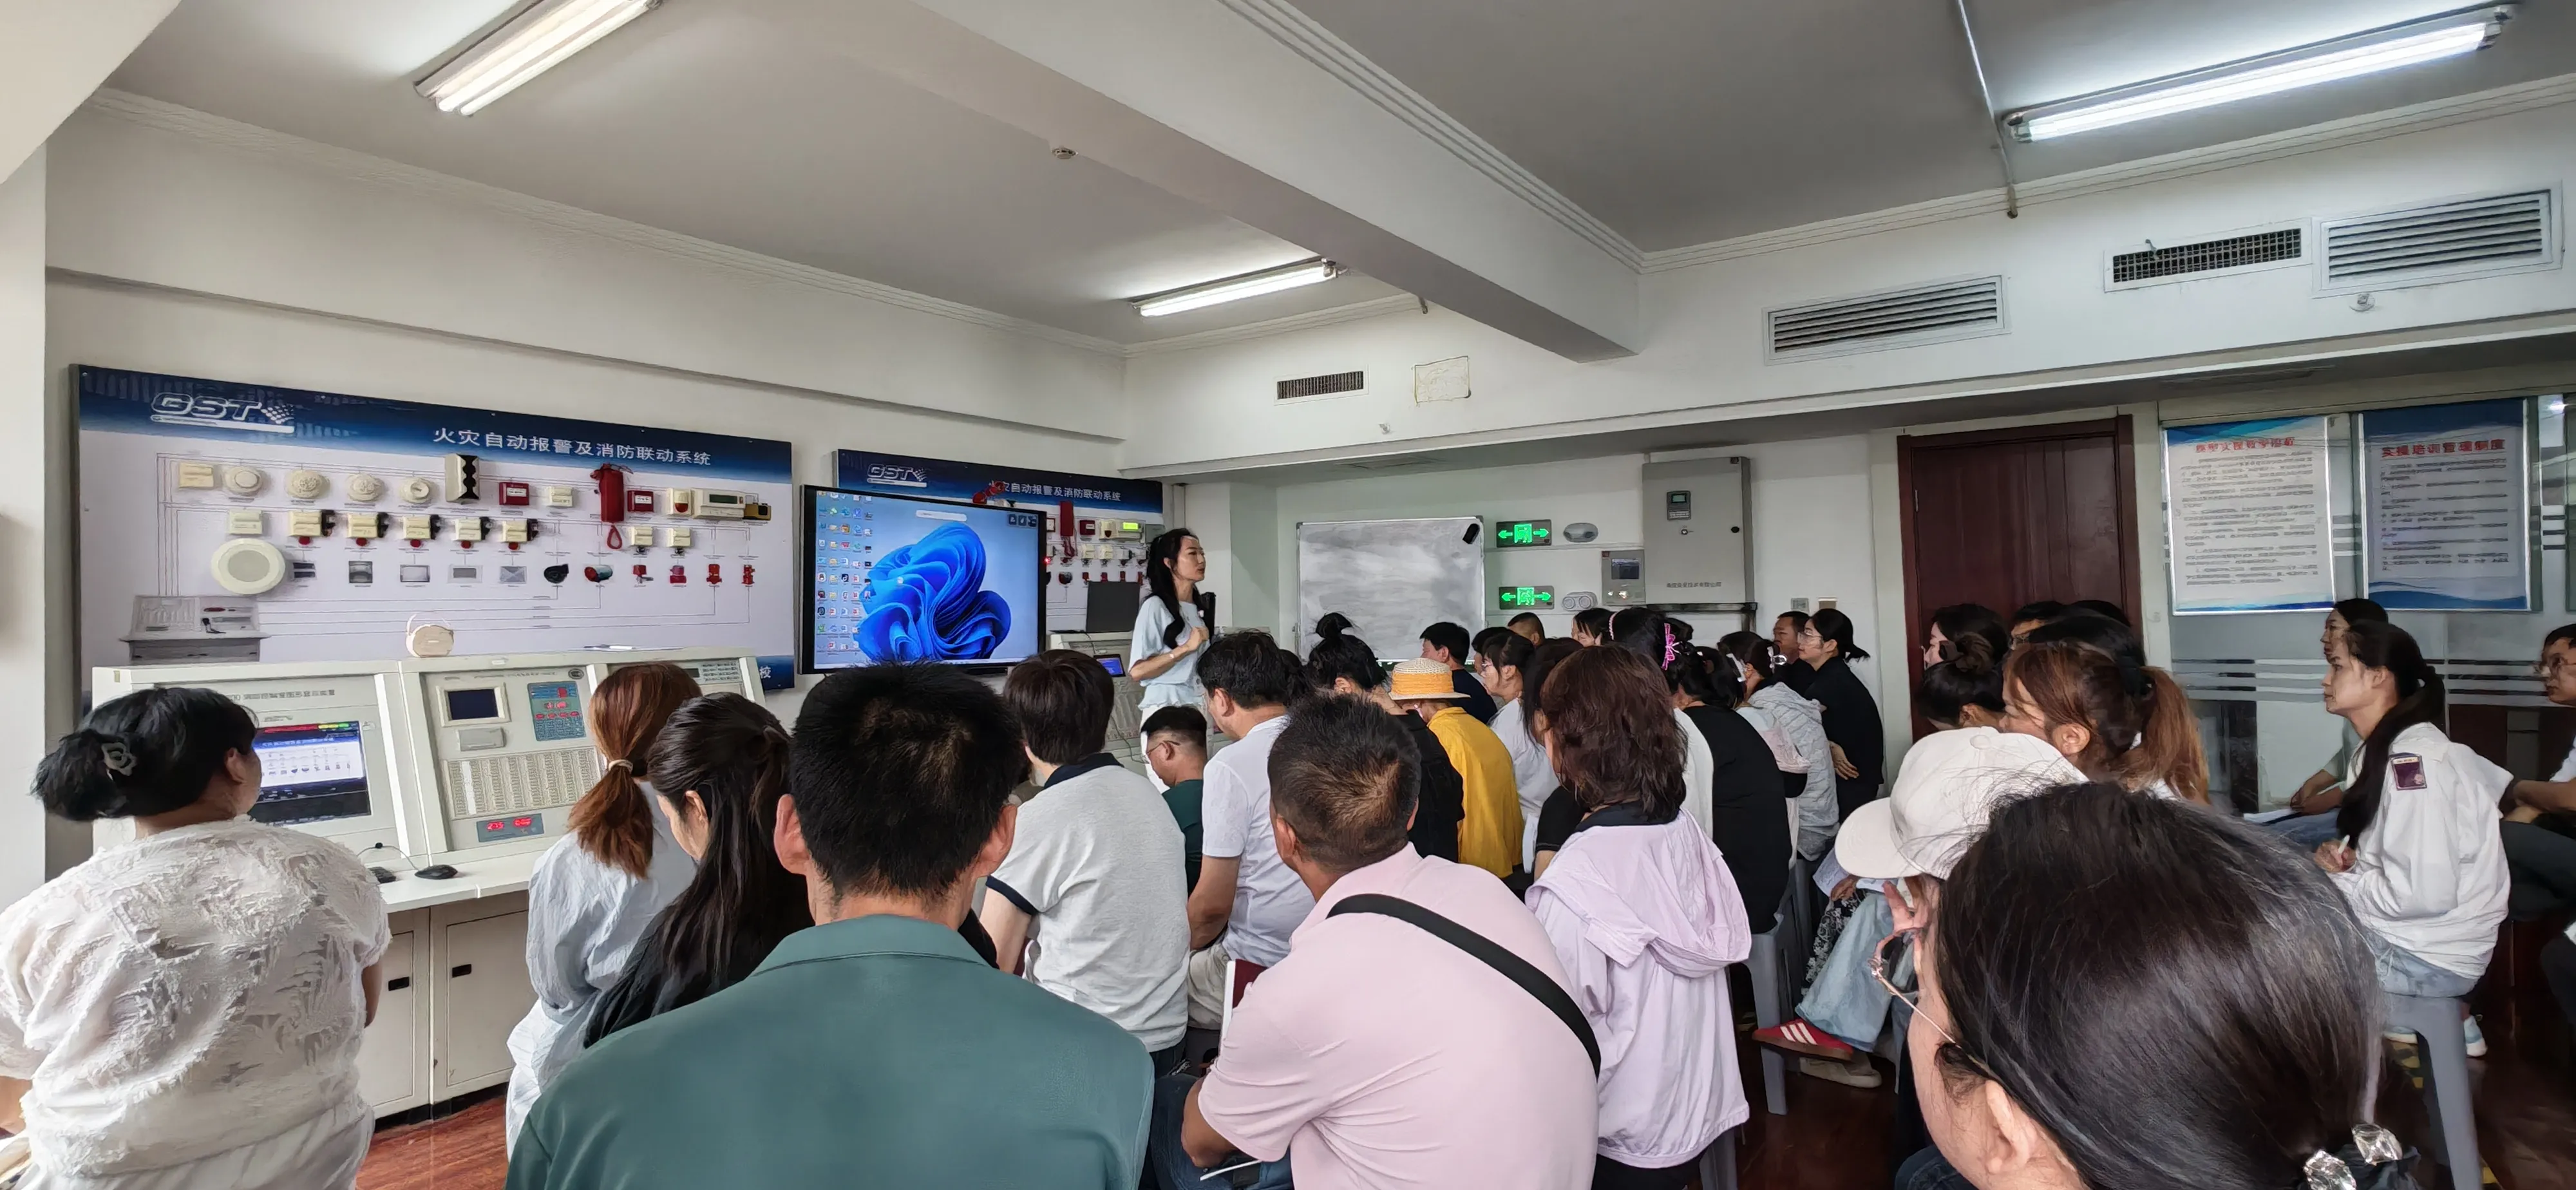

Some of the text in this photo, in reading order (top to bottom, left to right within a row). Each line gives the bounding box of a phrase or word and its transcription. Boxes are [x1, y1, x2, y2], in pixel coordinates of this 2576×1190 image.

[151, 392, 262, 421] GST
[433, 427, 711, 466] 火灾自动报警及消防联动系统
[867, 463, 914, 480] GST
